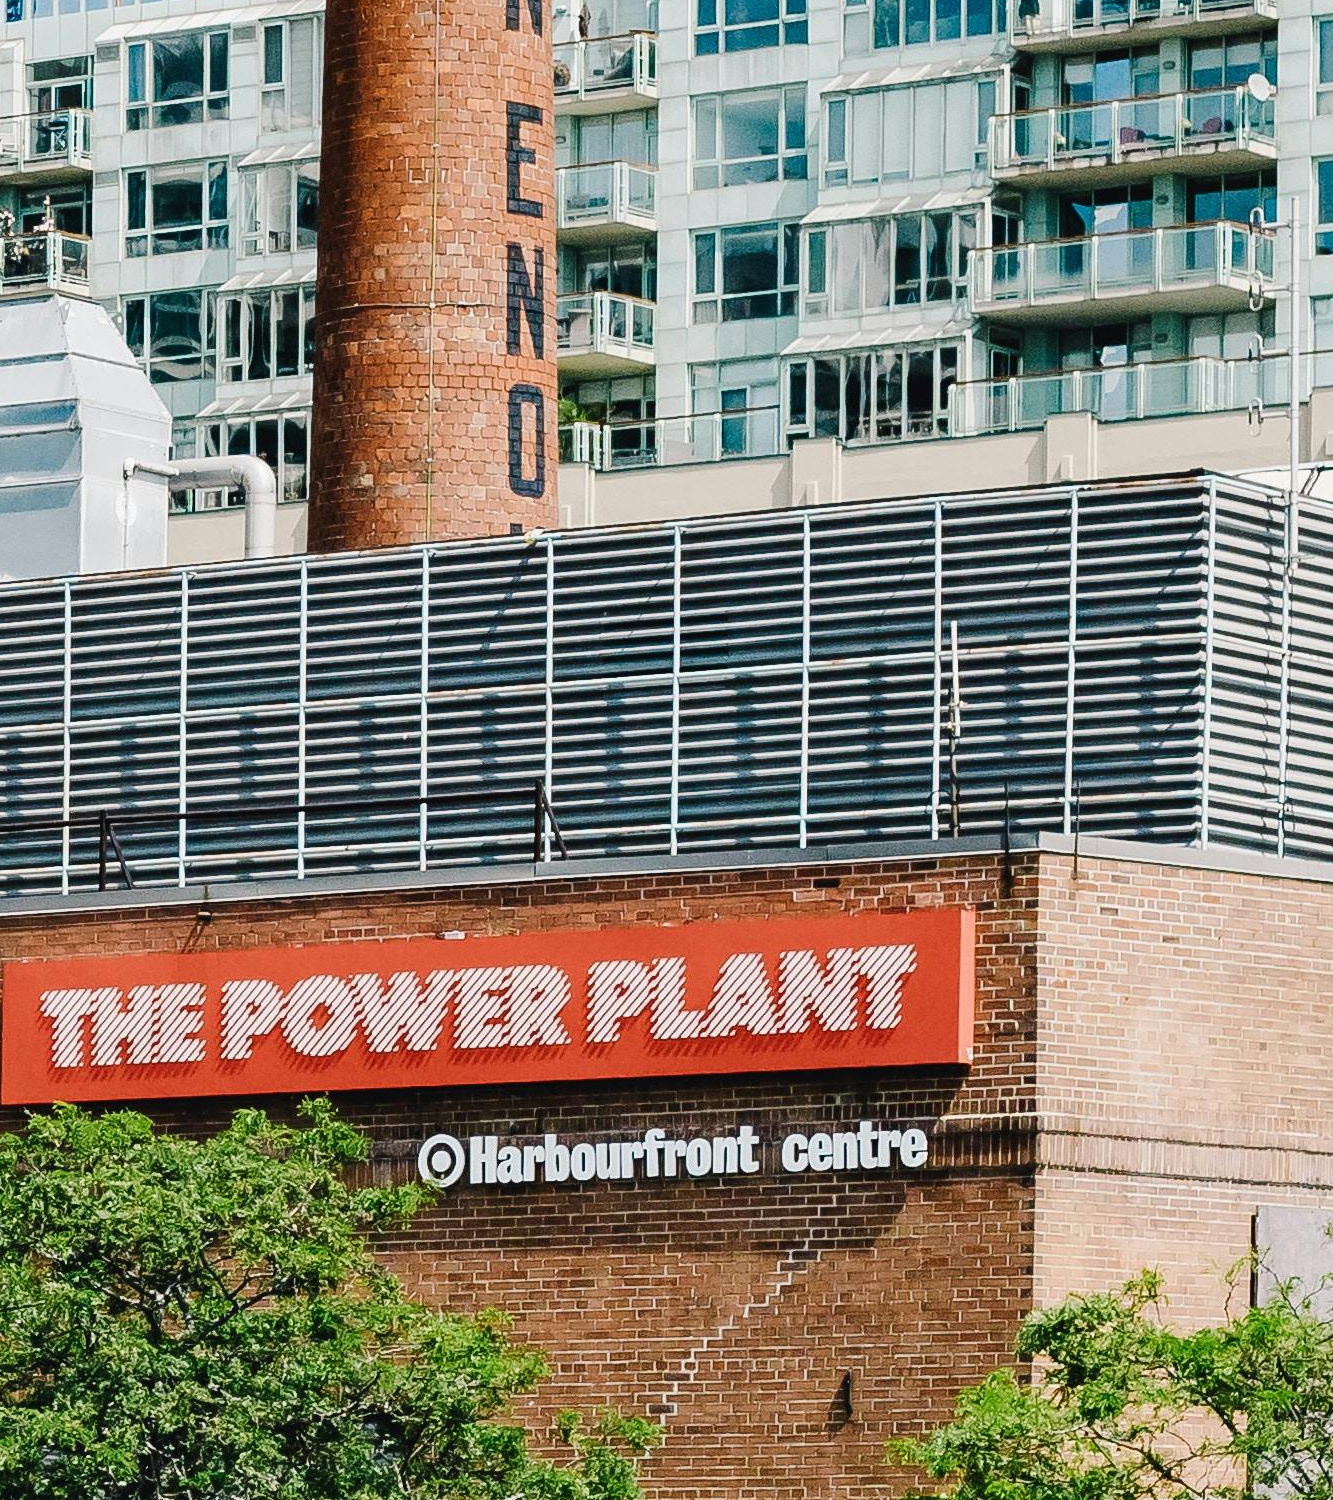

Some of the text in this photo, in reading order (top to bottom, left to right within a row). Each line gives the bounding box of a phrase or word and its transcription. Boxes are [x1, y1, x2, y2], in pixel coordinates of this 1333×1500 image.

[506, 101, 545, 534] ENO
[40, 944, 918, 1068] THE POWER PLANT
[470, 1121, 929, 1184] Harbourfront centre
